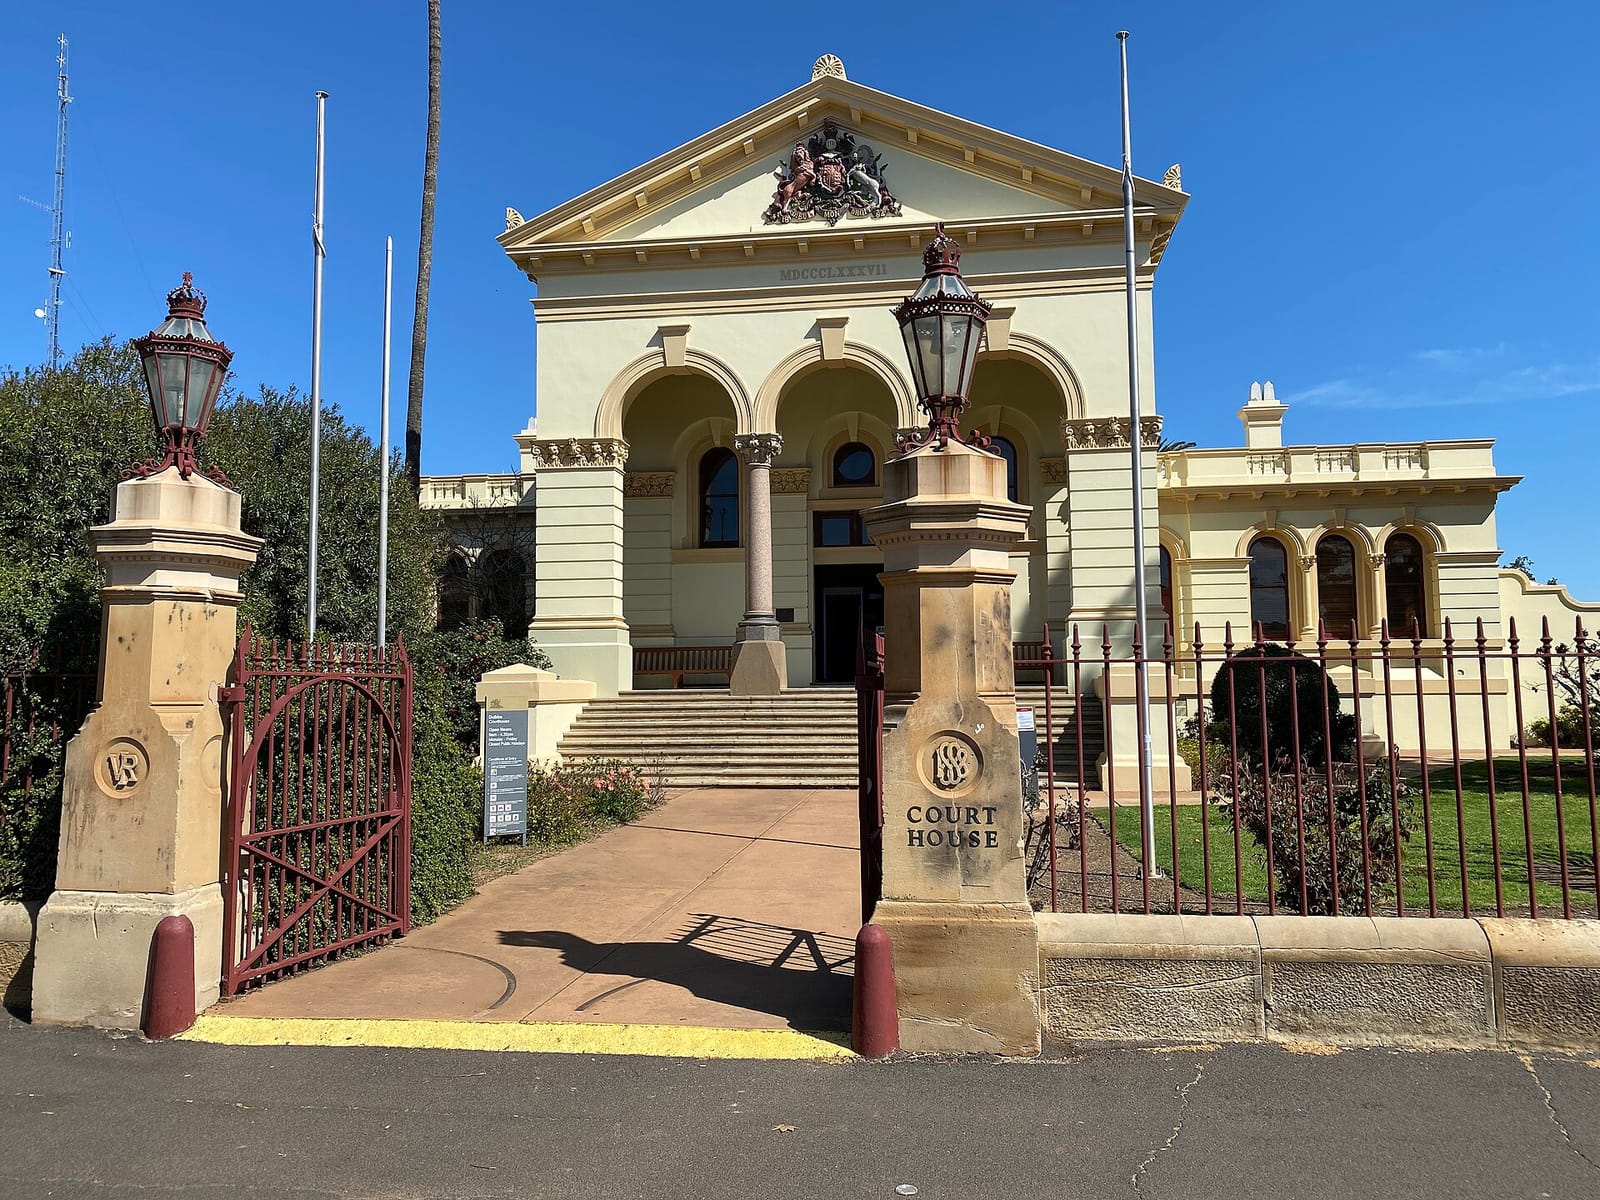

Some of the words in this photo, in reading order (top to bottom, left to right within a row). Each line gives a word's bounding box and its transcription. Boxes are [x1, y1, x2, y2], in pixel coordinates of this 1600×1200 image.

[824, 209, 840, 218] MON
[780, 263, 888, 281] MDCCCLXXXVII
[106, 751, 138, 789] VR
[906, 806, 997, 824] COURT
[907, 829, 999, 848] HOUSE
